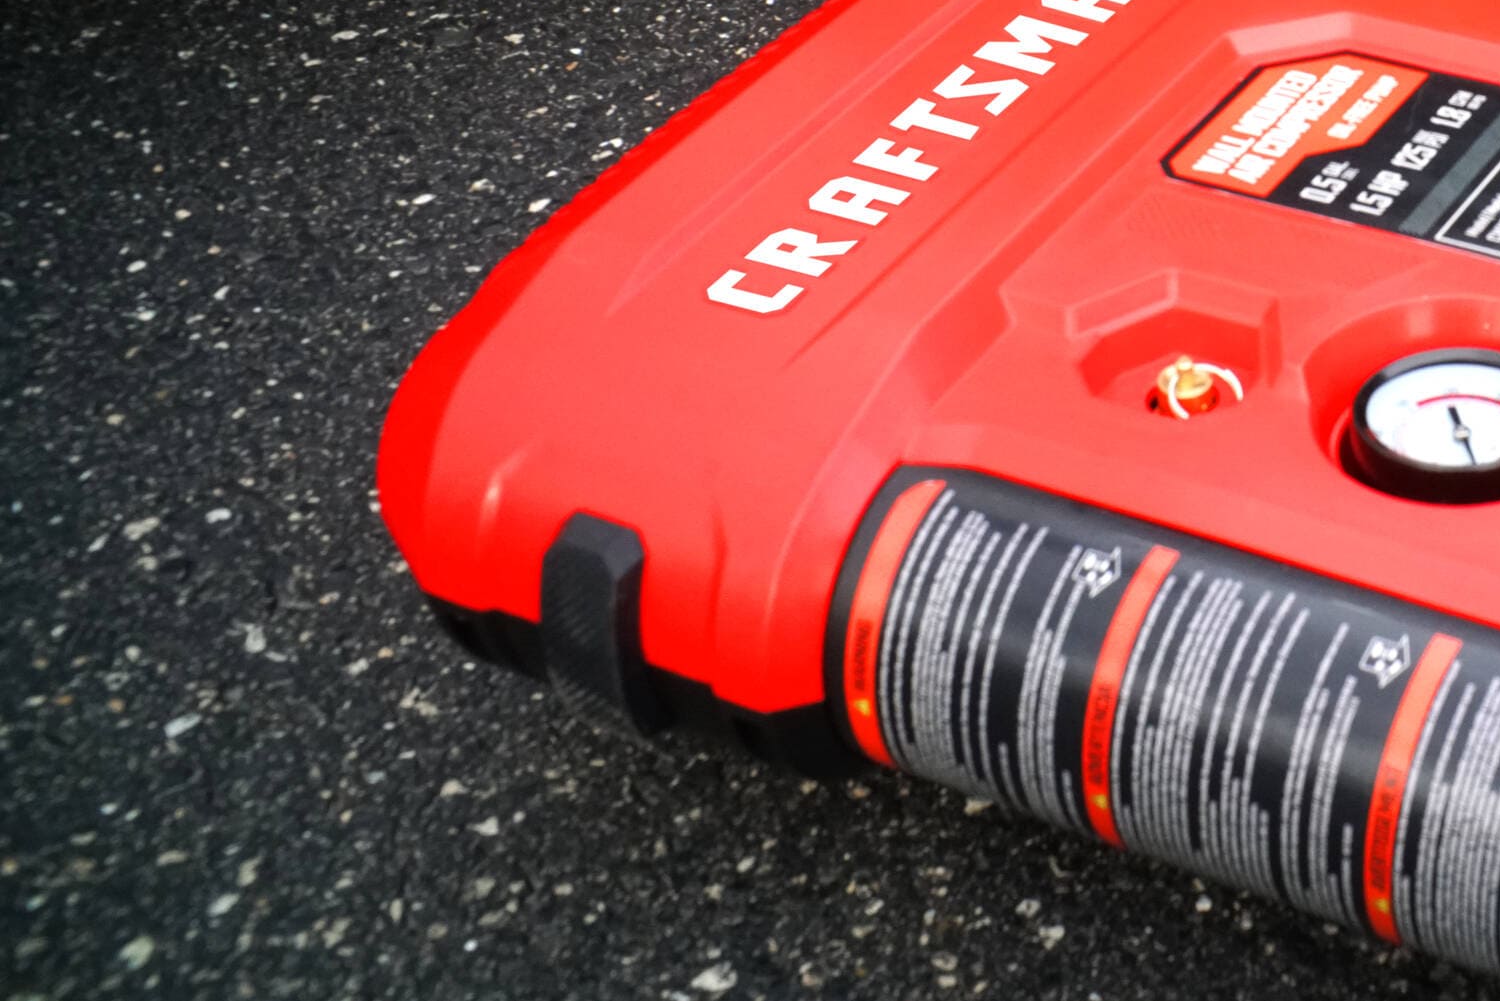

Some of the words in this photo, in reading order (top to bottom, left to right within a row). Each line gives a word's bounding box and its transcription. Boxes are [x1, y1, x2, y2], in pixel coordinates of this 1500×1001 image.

[1191, 135, 1256, 174] WALL
[1231, 69, 1319, 135] MOUNTED
[1250, 64, 1366, 157] COMPRESSOR
[1428, 106, 1473, 129] 1.8
[1227, 152, 1276, 184] AIR
[1389, 142, 1439, 170] 125
[1298, 174, 1348, 204] 0.5
[1366, 169, 1413, 196] HP
[1348, 189, 1395, 215] 1.5
